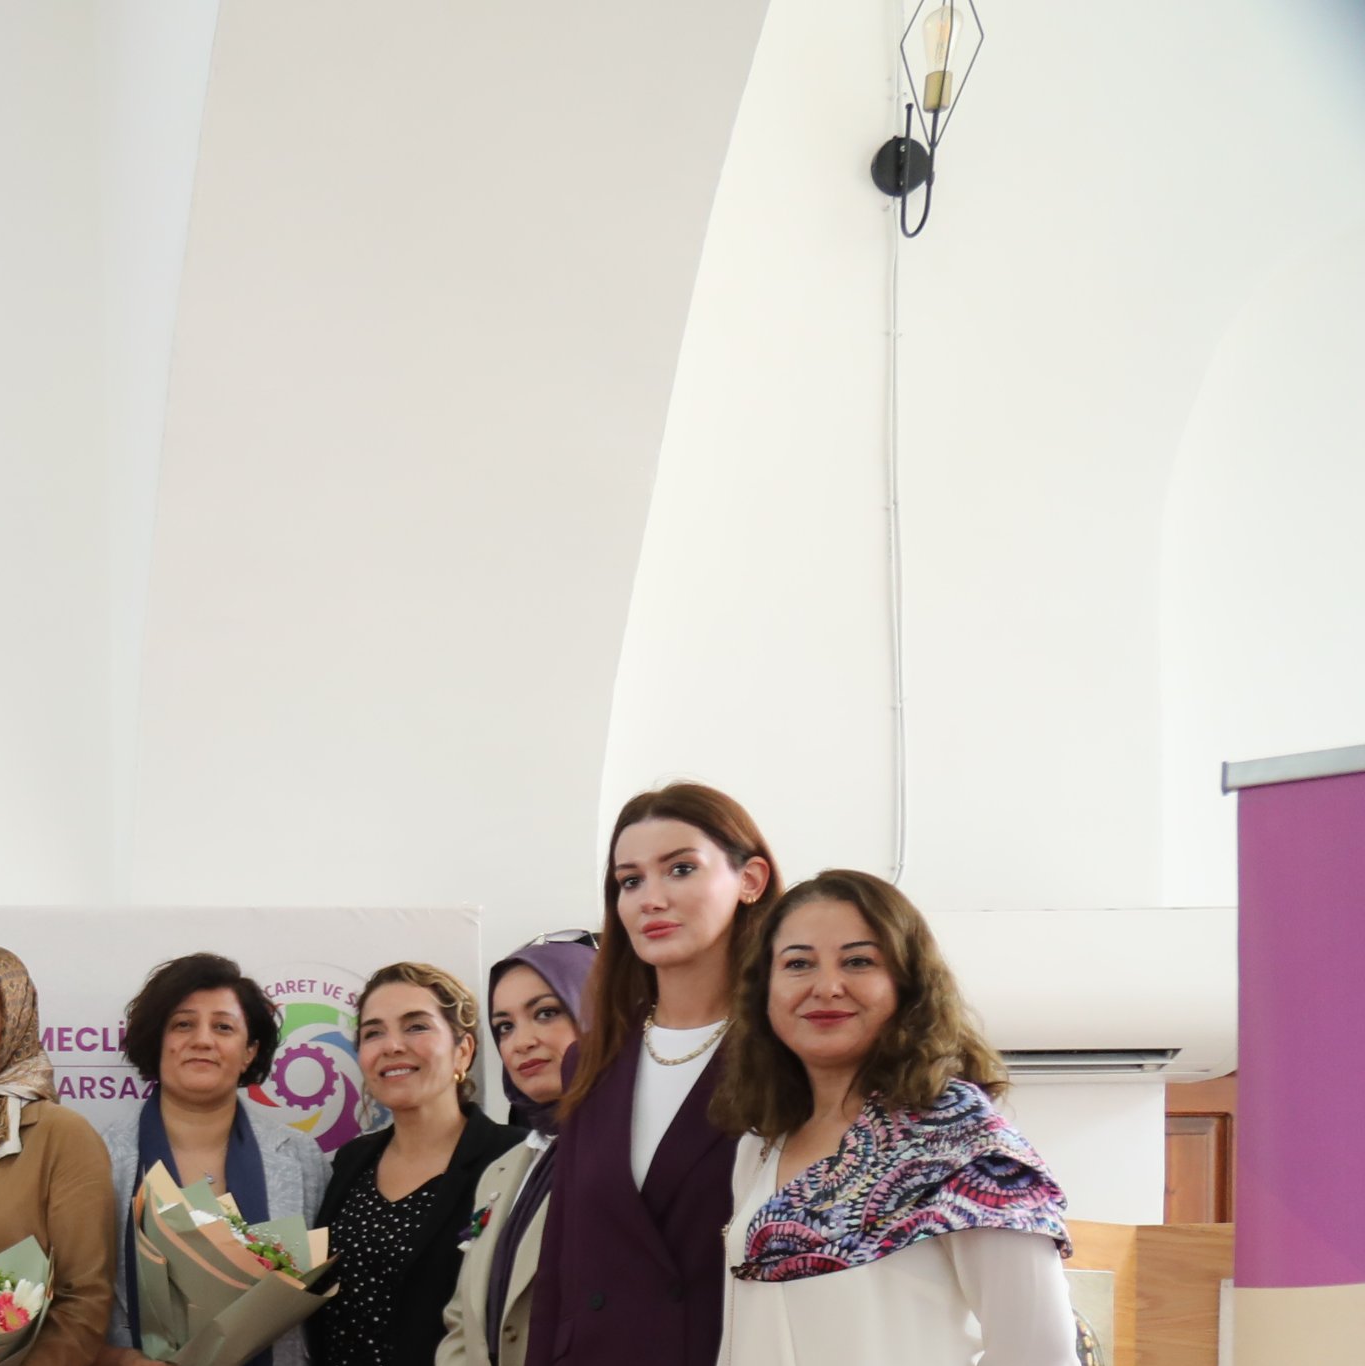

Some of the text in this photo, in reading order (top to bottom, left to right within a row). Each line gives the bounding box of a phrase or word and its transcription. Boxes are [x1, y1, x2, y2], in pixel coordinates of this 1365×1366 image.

[264, 980, 343, 1000] CARET VE
[40, 1020, 127, 1053] MECLİ
[57, 1076, 157, 1100] ARSAZ
